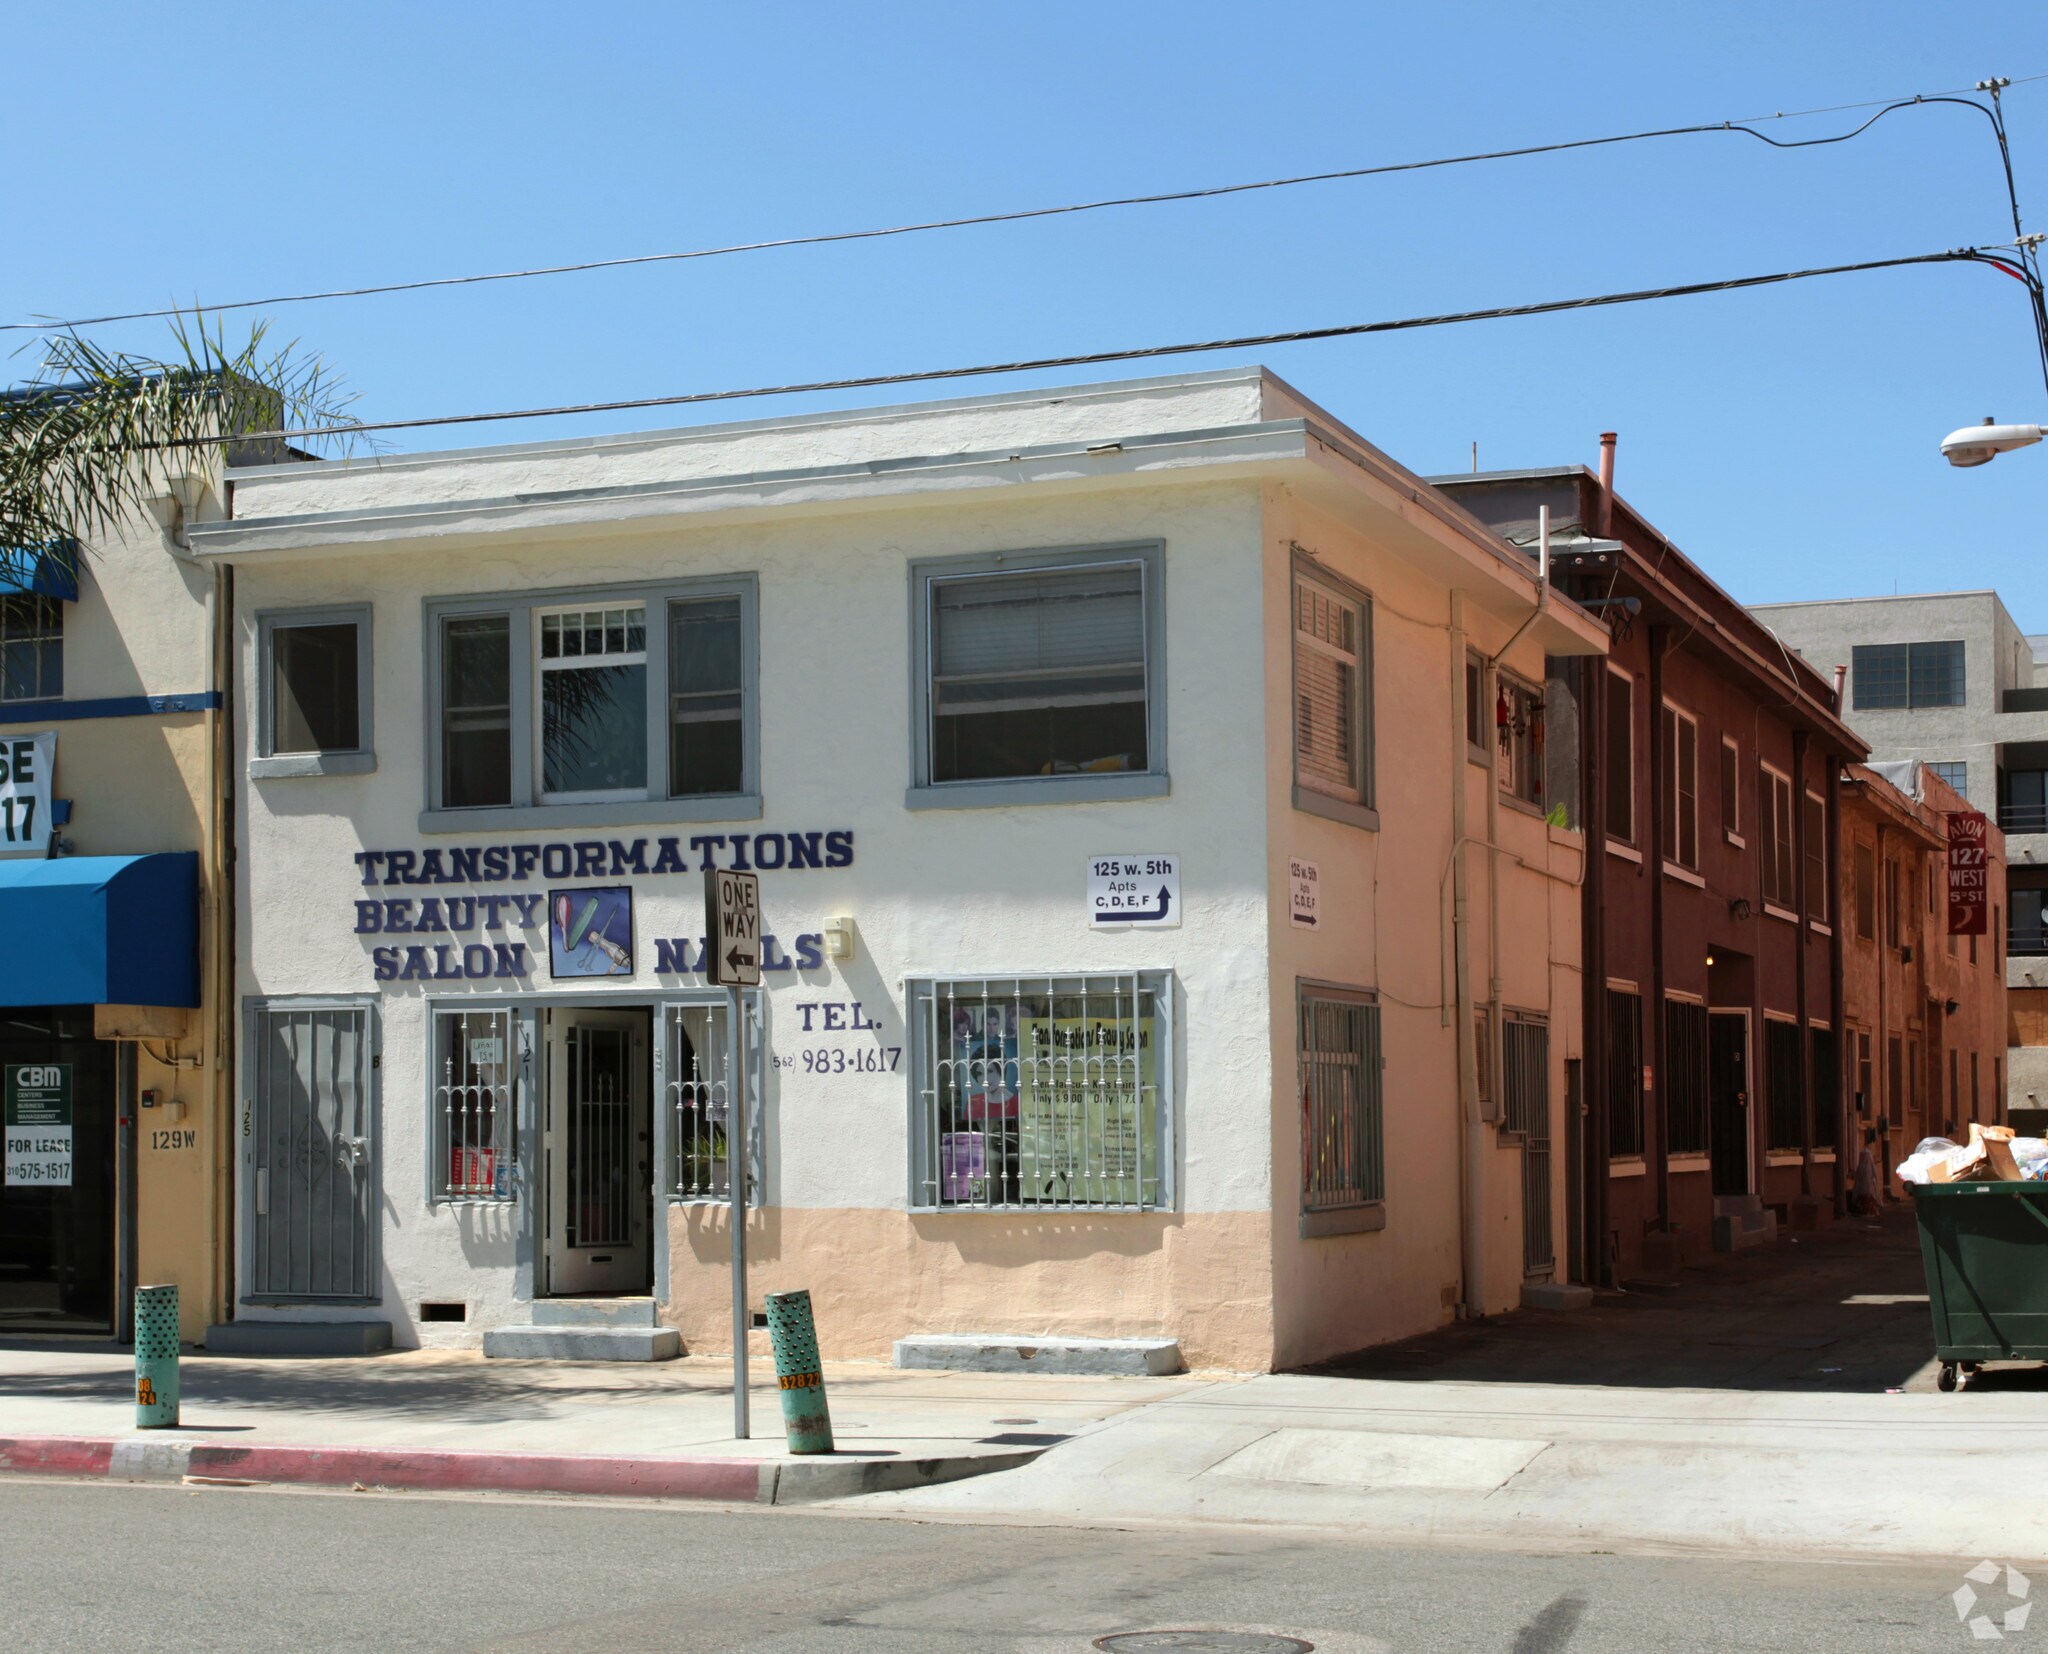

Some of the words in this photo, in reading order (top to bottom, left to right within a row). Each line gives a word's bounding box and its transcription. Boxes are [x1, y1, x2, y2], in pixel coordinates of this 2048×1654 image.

[1949, 820, 1985, 839] AVON
[354, 831, 854, 886] TRANSFORMATIONS
[1950, 847, 1985, 865] 127
[1094, 862, 1120, 876] 125
[1124, 864, 1141, 875] w.
[1146, 860, 1172, 875] 5th
[1291, 862, 1300, 878] 125
[1308, 866, 1317, 881] 5th
[1949, 869, 1985, 887] WEST
[723, 880, 753, 908] ONE
[1108, 881, 1137, 893] Apts
[1969, 890, 1985, 902] ST.
[1095, 896, 1109, 908] C,
[1111, 896, 1124, 908] D,
[1127, 896, 1139, 907] E,
[1142, 896, 1150, 905] F
[354, 894, 543, 934] BEAUTY
[723, 911, 755, 939] WAY
[373, 943, 527, 981] SALON
[654, 933, 823, 973] NLS
[796, 1002, 882, 1031] TEL.
[1032, 1022, 1094, 1049] Tranforations
[1096, 1021, 1124, 1054] Beauy
[1126, 1025, 1147, 1049] Saon
[770, 1052, 796, 1074] (562)
[17, 1066, 61, 1087] CBM
[8, 1140, 31, 1152] FOR
[36, 1140, 70, 1152] LEASE
[20, 1163, 70, 1179] 575-1517
